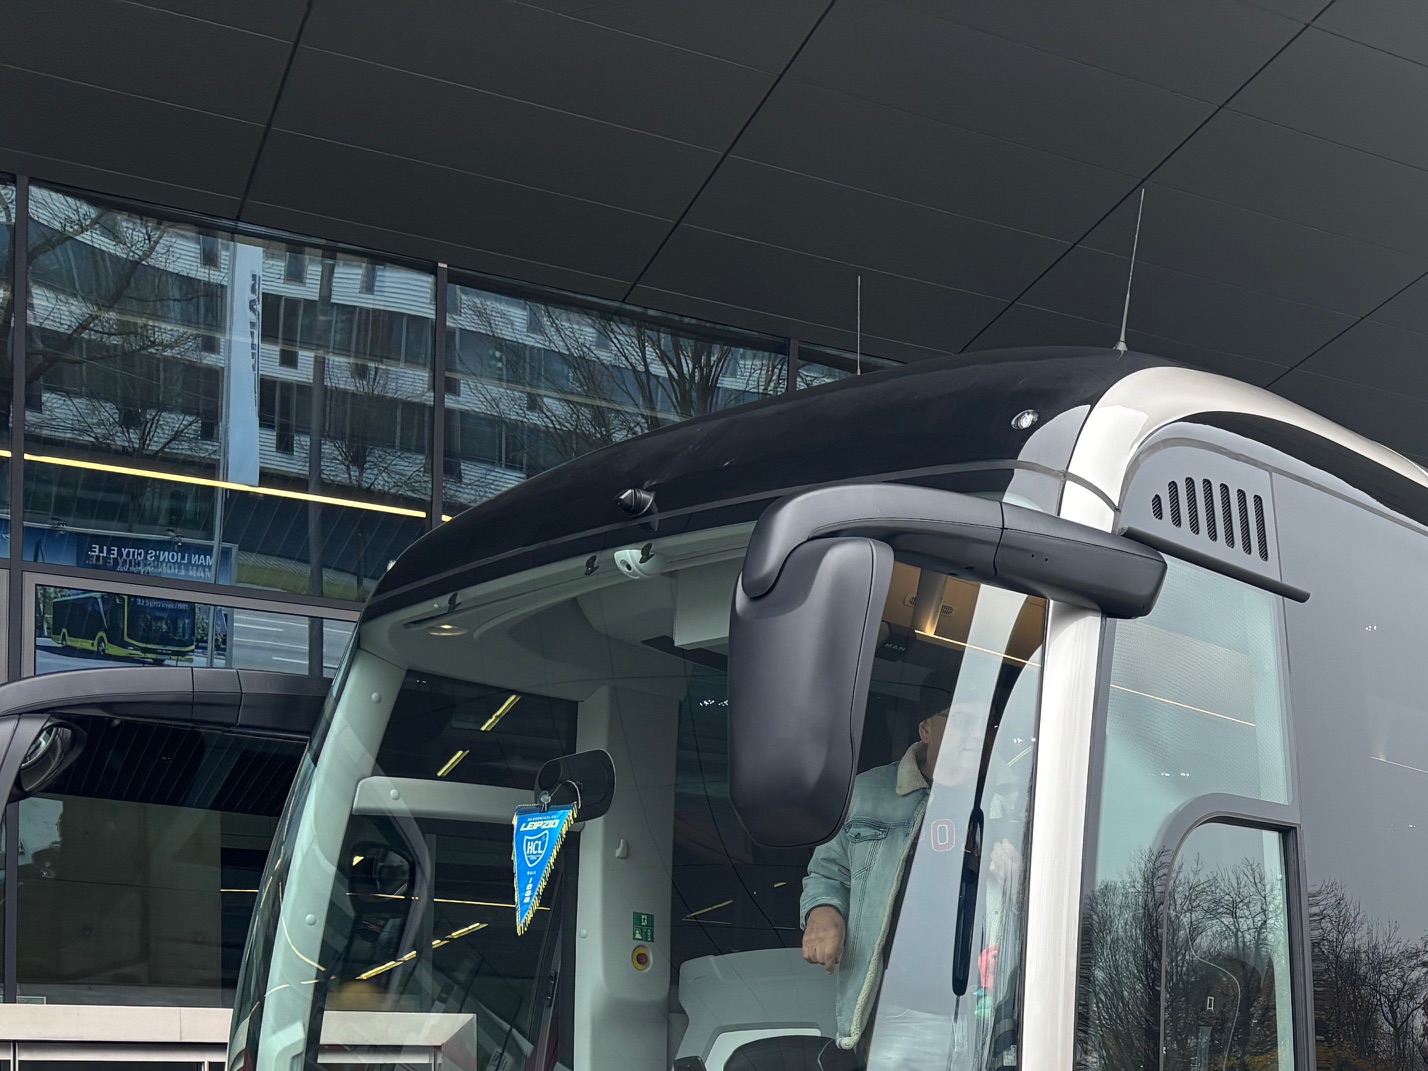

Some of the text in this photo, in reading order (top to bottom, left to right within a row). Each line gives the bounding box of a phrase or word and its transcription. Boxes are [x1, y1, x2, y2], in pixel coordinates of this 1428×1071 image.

[885, 643, 906, 652] MAN
[520, 819, 559, 831] LEIPZIG
[526, 840, 543, 855] HCL
